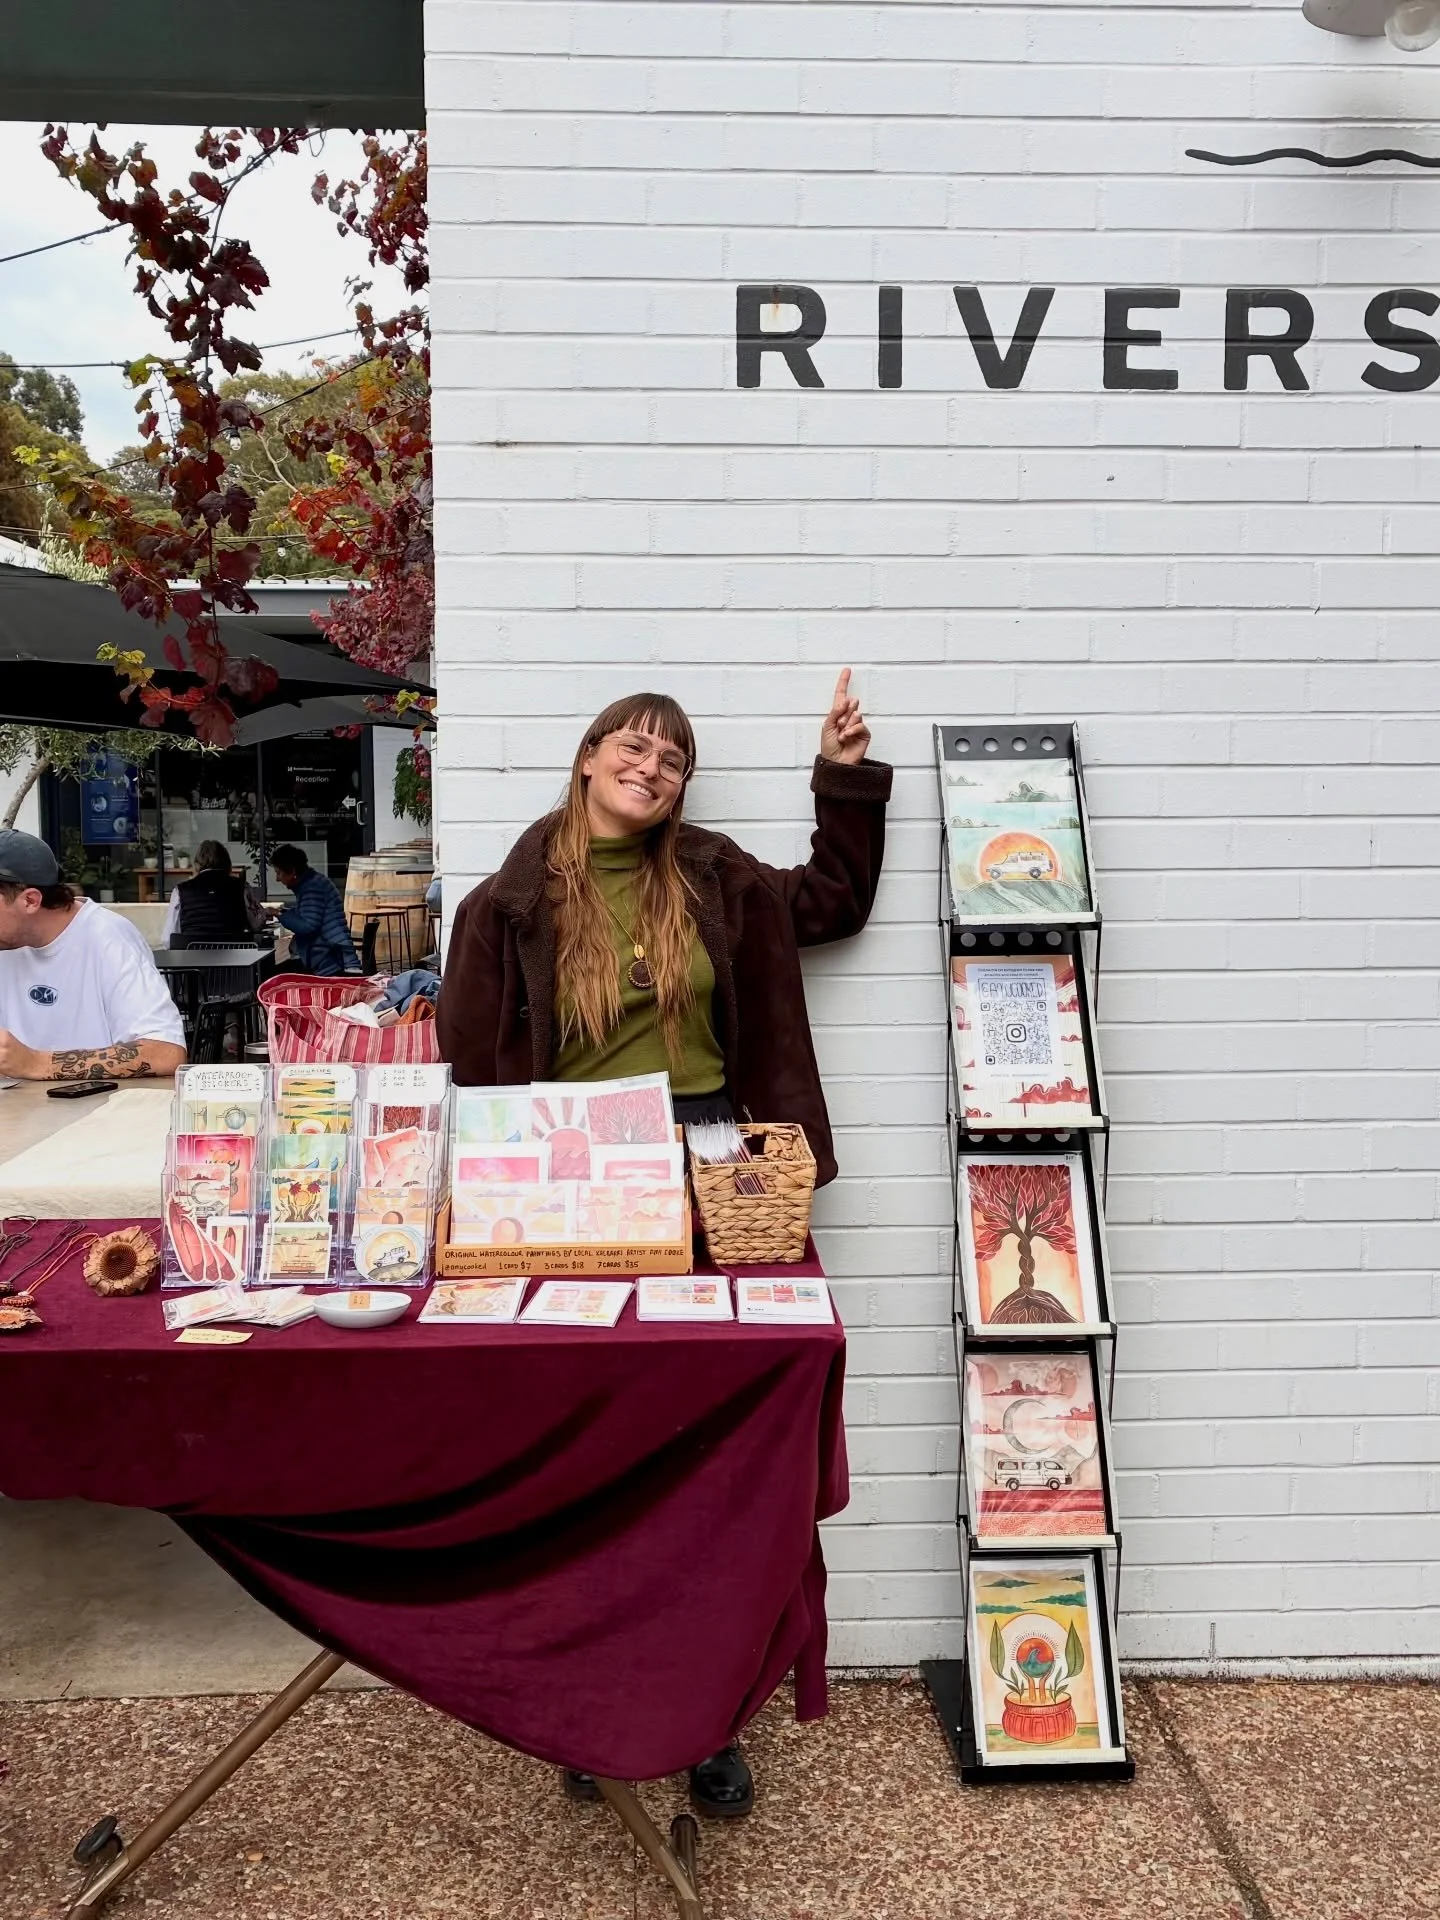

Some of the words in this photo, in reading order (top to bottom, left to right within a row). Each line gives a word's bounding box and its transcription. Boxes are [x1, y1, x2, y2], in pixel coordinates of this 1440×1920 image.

[735, 284, 1440, 392] RIVERS
[295, 775, 330, 784] Reception
[194, 1071, 253, 1080] WATERPROOF
[201, 1079, 249, 1088] STICKERS
[444, 1250, 478, 1258] ORIGINAL
[563, 1248, 573, 1257] BY
[573, 1249, 593, 1257] LOCAL
[626, 1248, 647, 1256] ARTIST
[520, 1260, 532, 1271] $7
[571, 1260, 585, 1270] $18
[624, 1259, 639, 1269] $35
